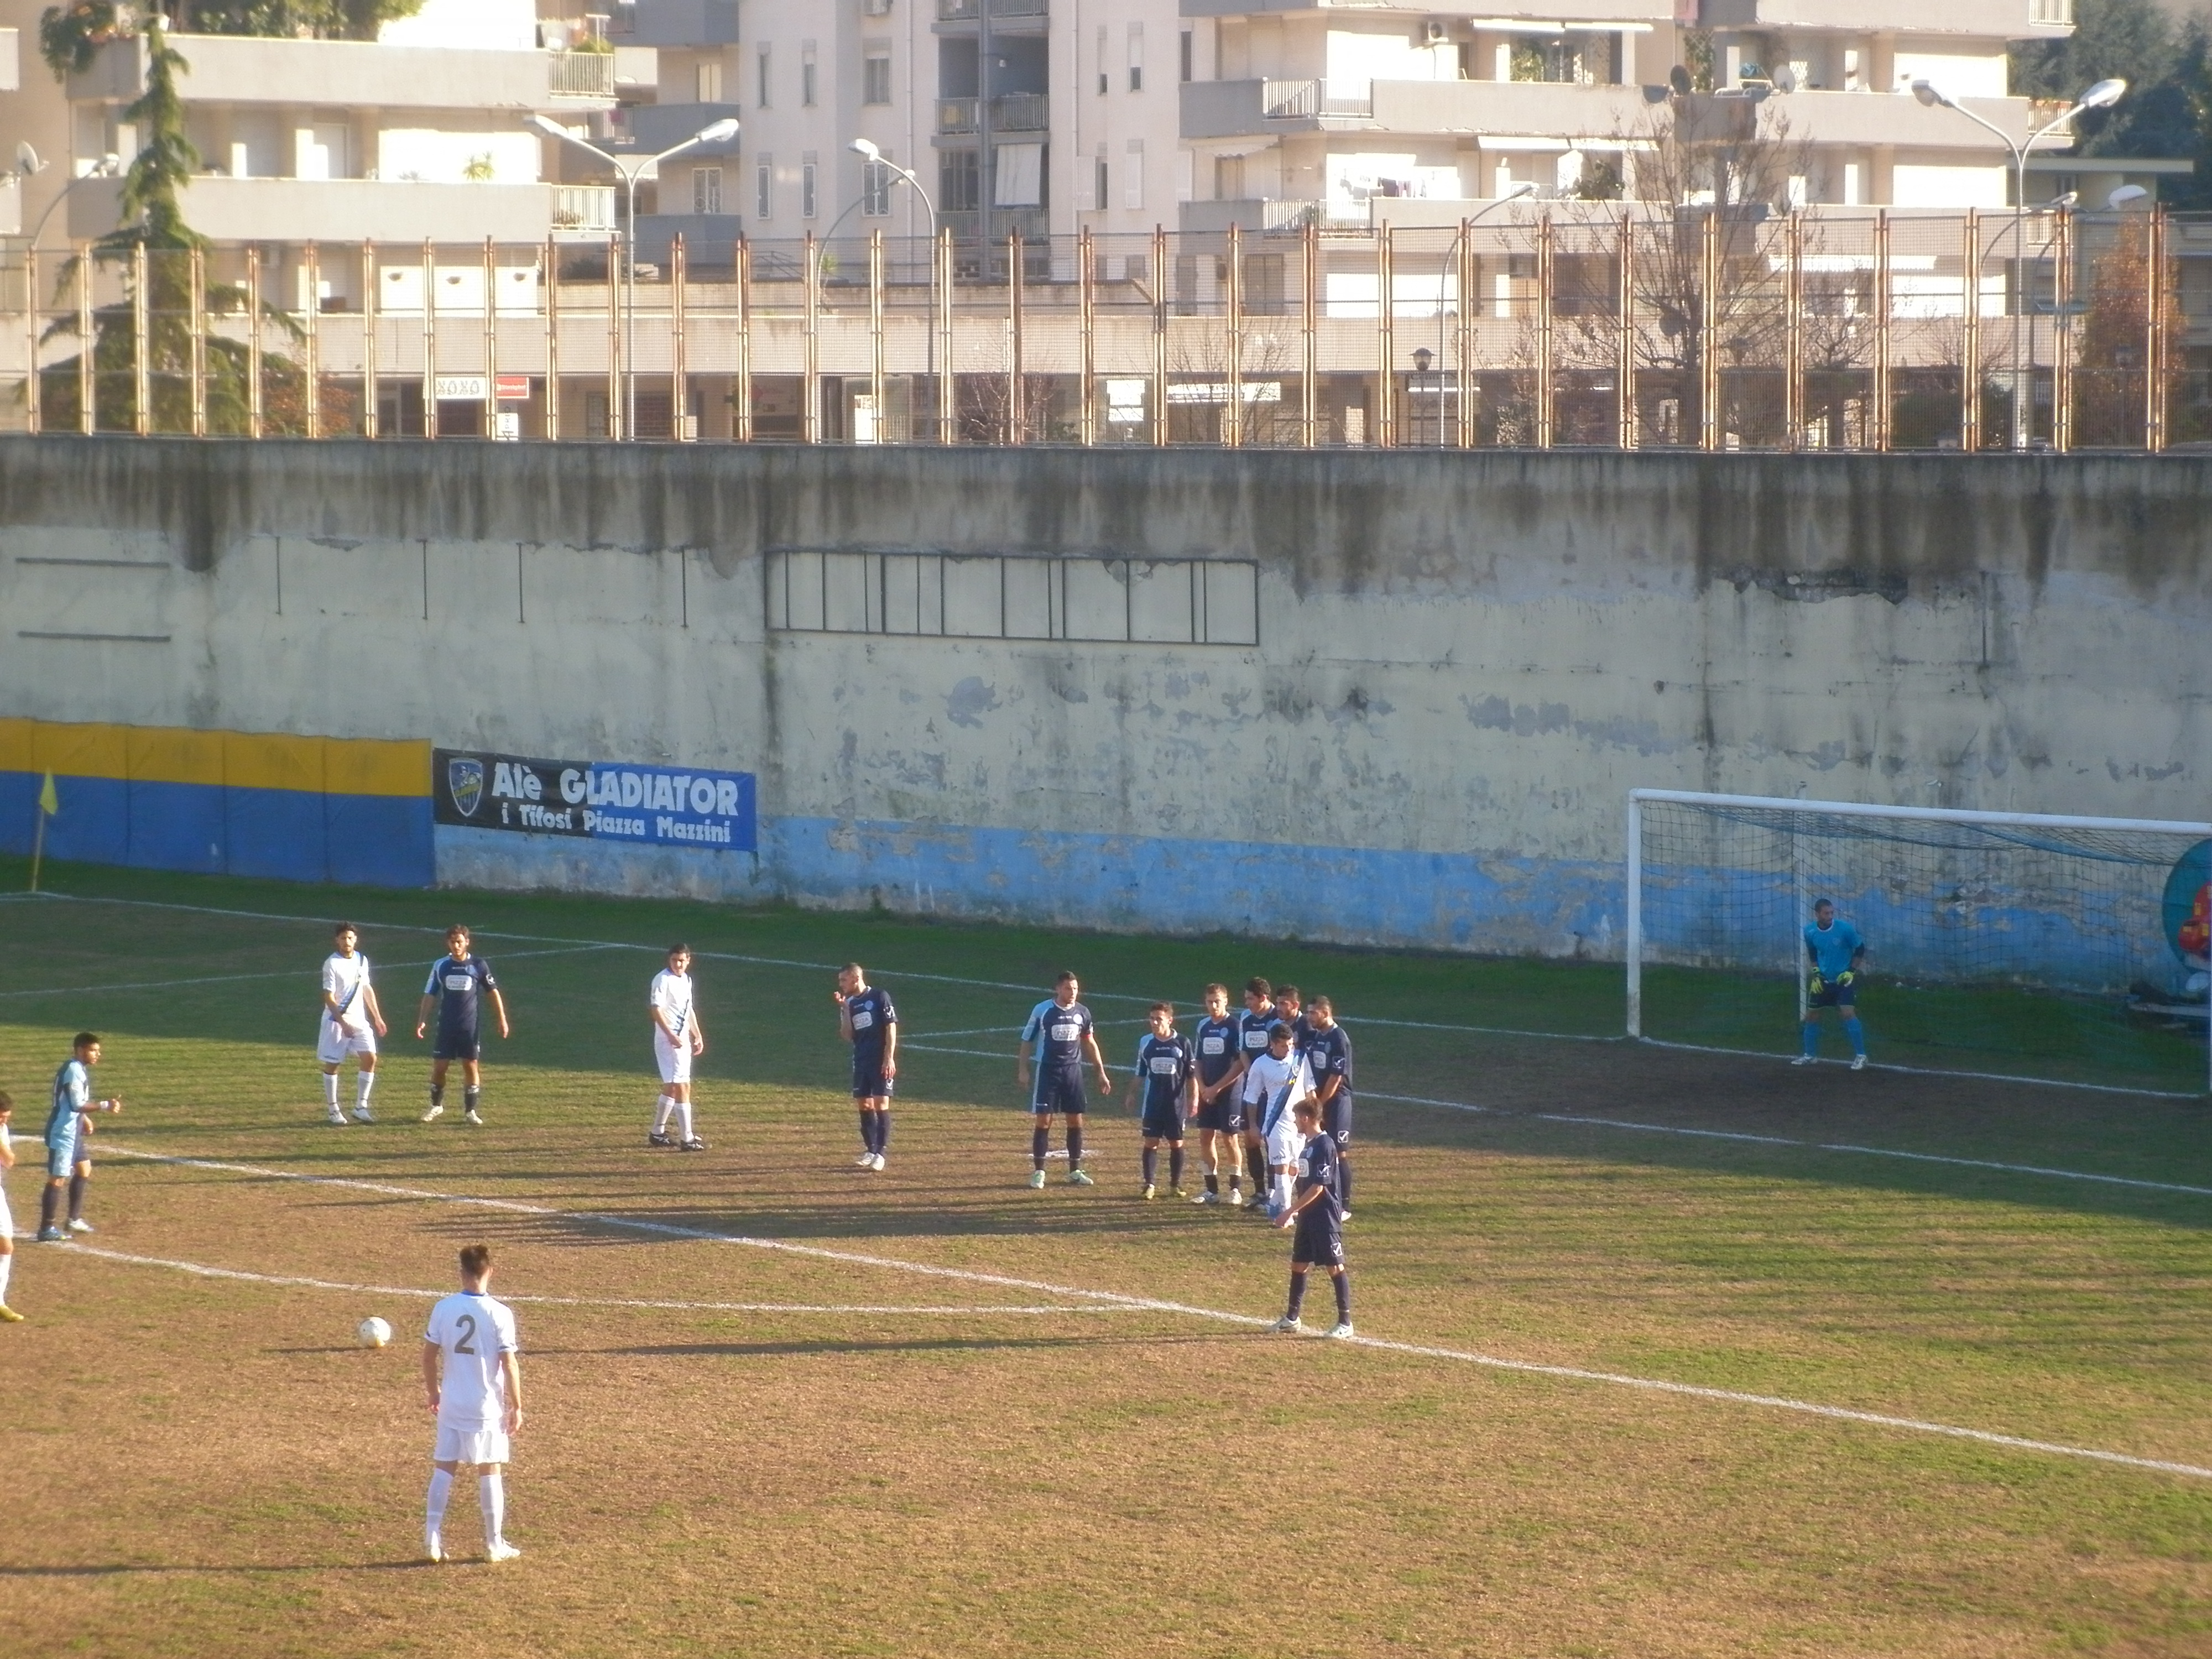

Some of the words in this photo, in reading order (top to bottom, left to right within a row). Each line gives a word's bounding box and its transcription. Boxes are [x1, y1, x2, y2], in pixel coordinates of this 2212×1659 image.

[492, 762, 542, 800] Alè
[560, 768, 739, 816] GLADIATOR
[502, 802, 509, 824] i
[519, 805, 573, 830] Tifosi
[582, 810, 645, 836] Piazza
[656, 816, 731, 843] Mazzini
[454, 1314, 476, 1355] 2
